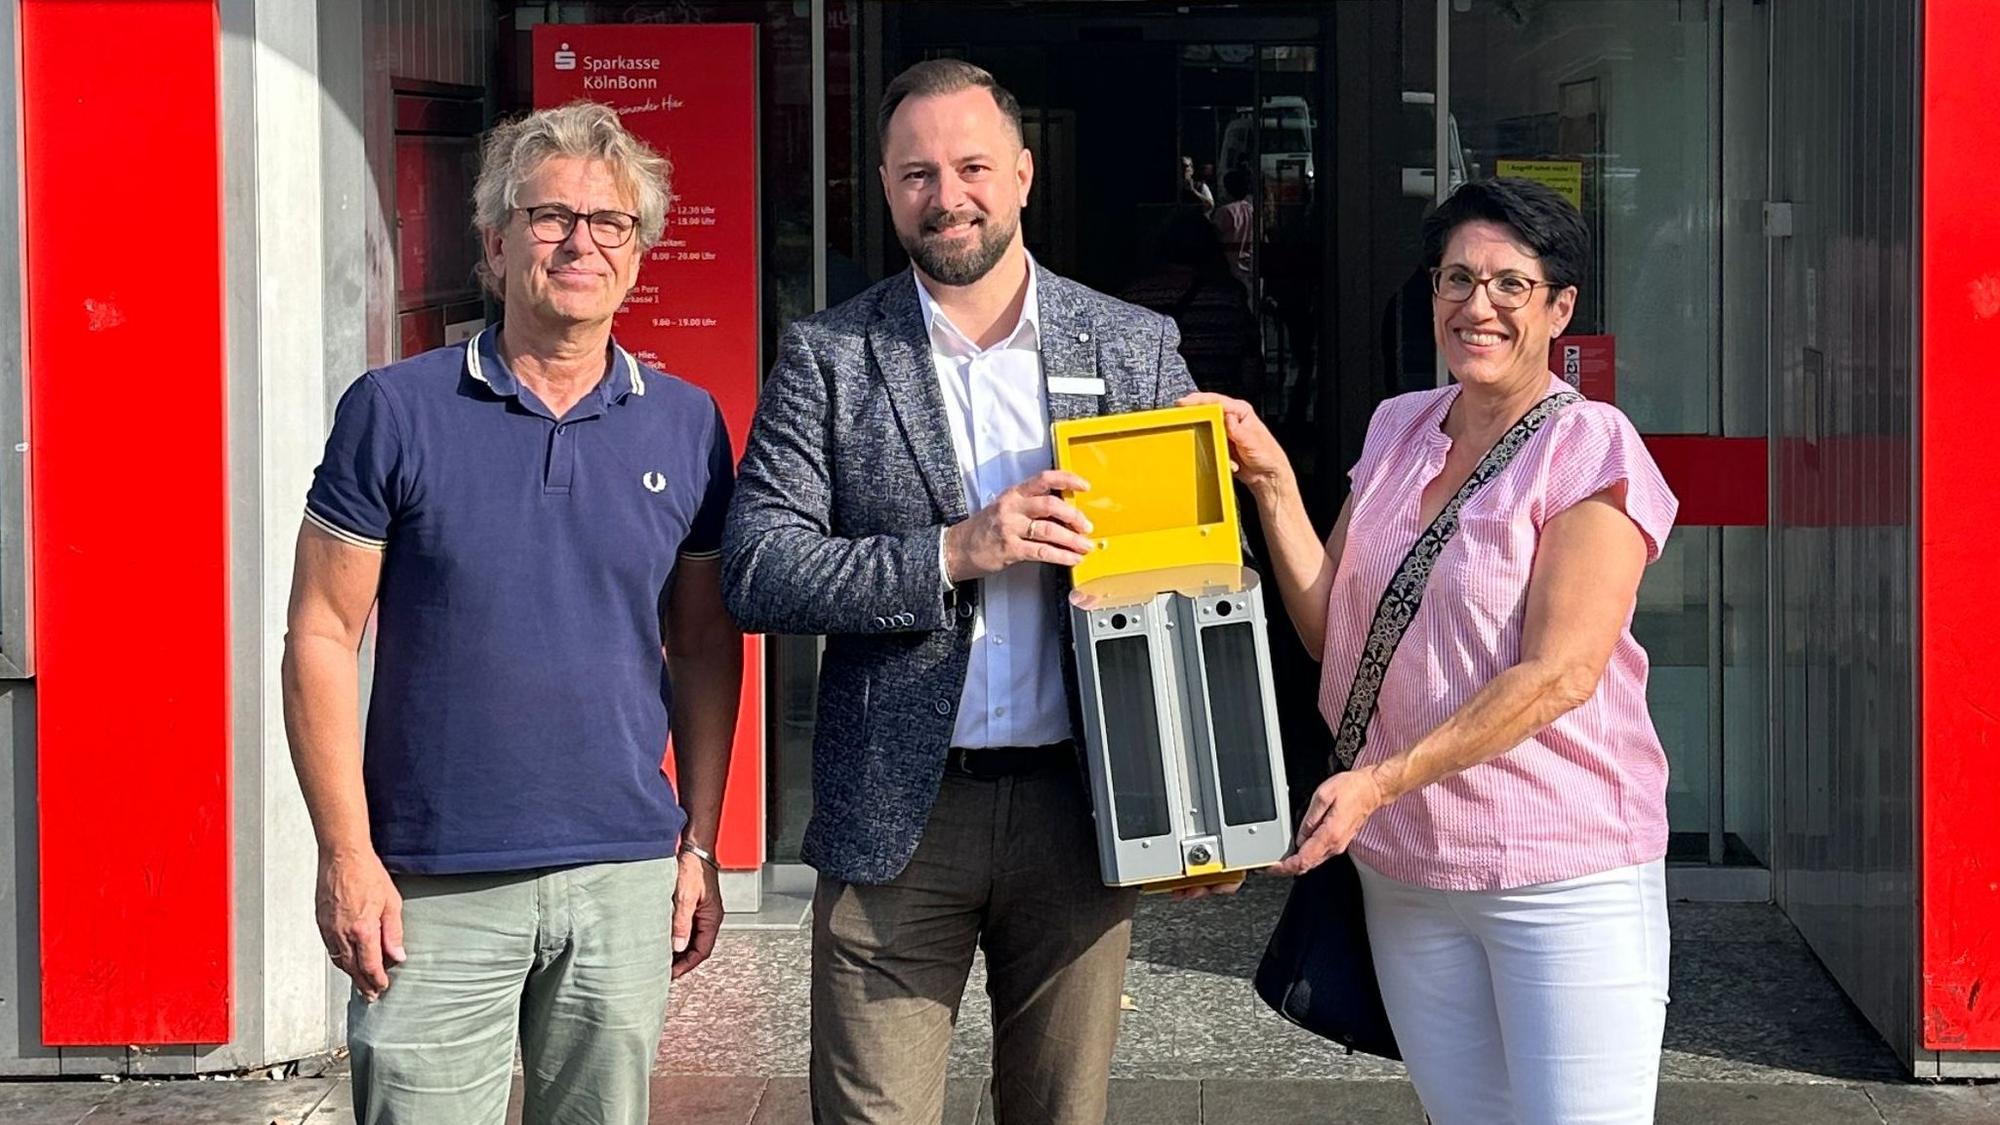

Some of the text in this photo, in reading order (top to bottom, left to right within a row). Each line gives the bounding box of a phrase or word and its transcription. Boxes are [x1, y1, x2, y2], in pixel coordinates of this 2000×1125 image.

[583, 55, 660, 72] Sparkasse
[584, 75, 657, 89] KölnBonn
[701, 217, 716, 225] Uhr
[677, 252, 700, 260] 20.00
[701, 252, 716, 260] Uhr
[641, 285, 659, 293] Porz
[678, 318, 700, 326] 19.00
